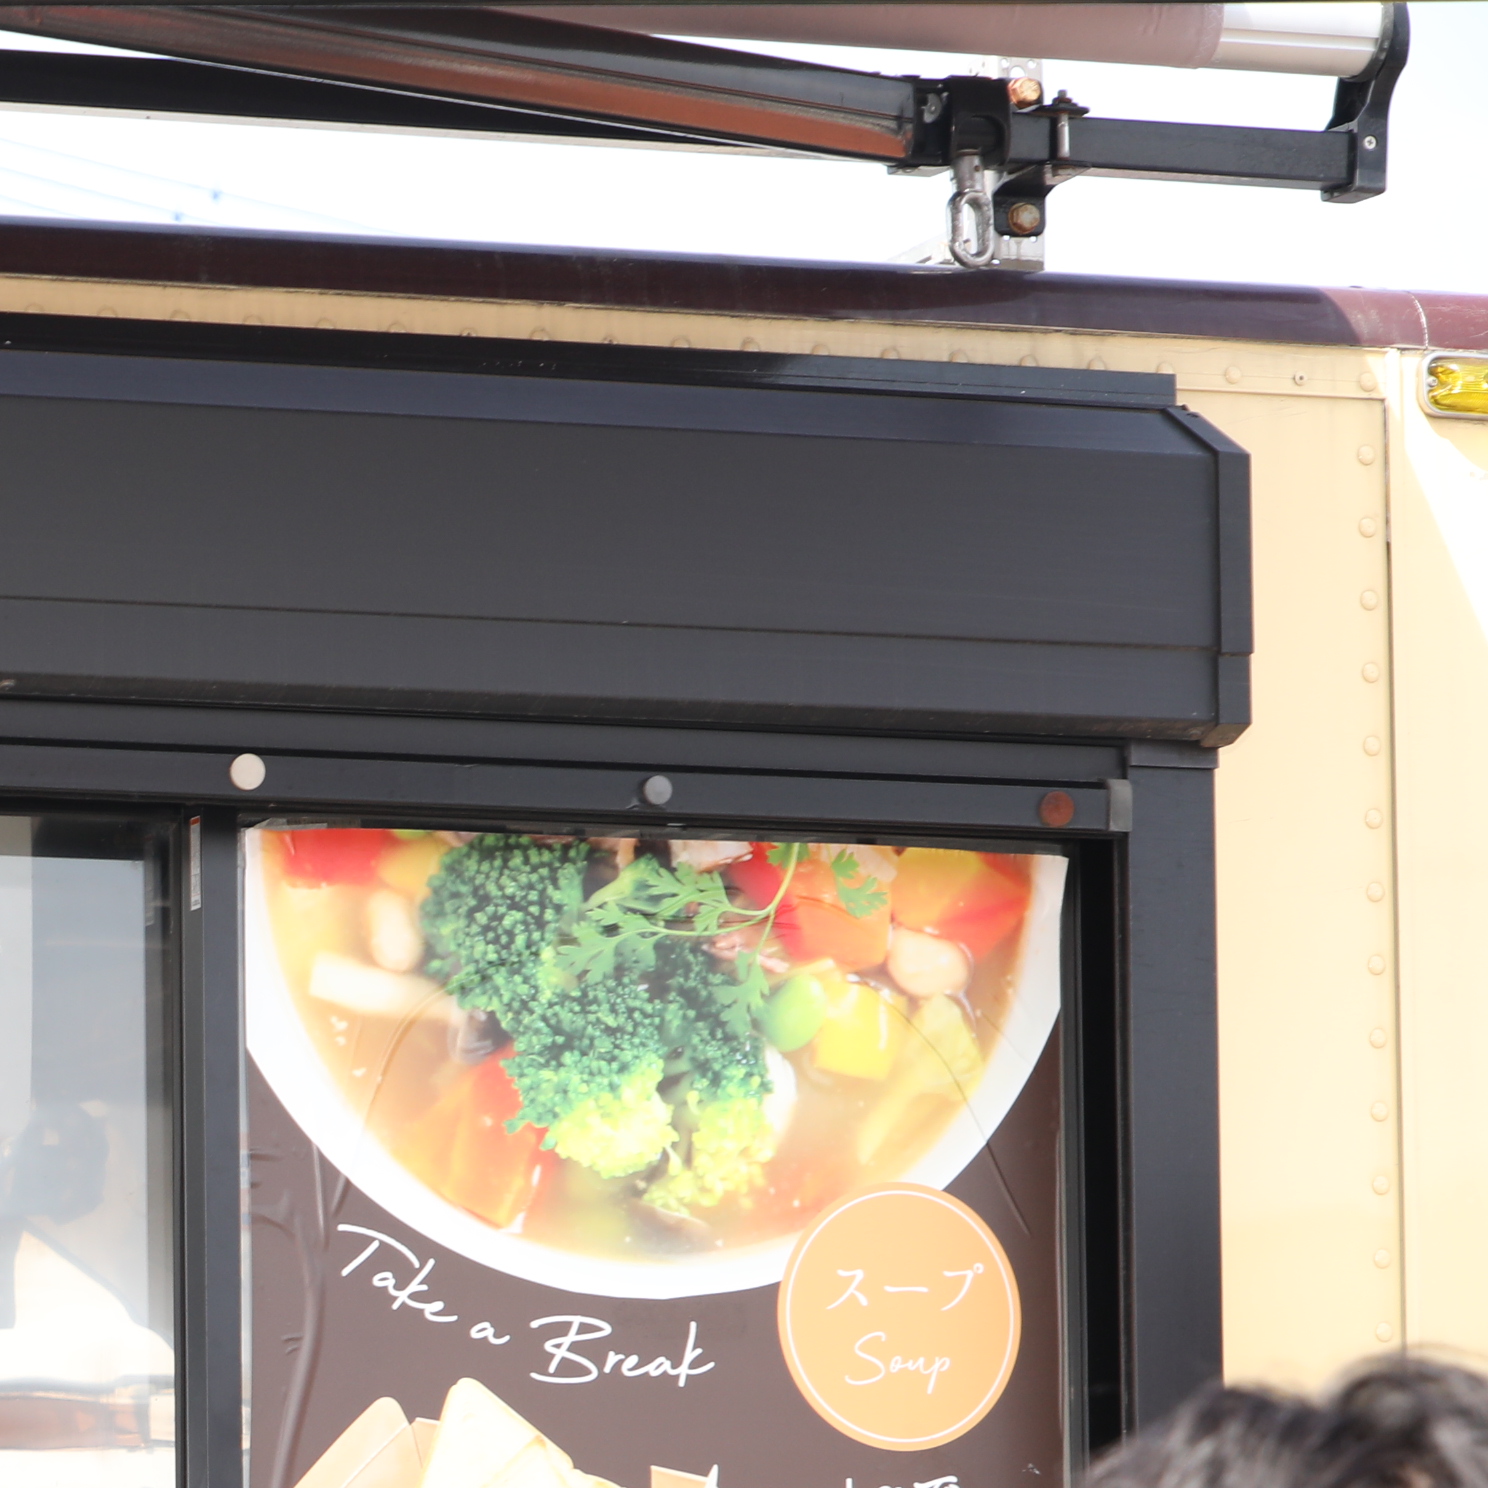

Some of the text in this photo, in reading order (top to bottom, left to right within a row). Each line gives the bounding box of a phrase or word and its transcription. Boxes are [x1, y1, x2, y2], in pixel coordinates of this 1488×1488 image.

[337, 1223, 716, 1387] Take a Break
[825, 1261, 984, 1313] スープ
[844, 1331, 952, 1394] Soup
